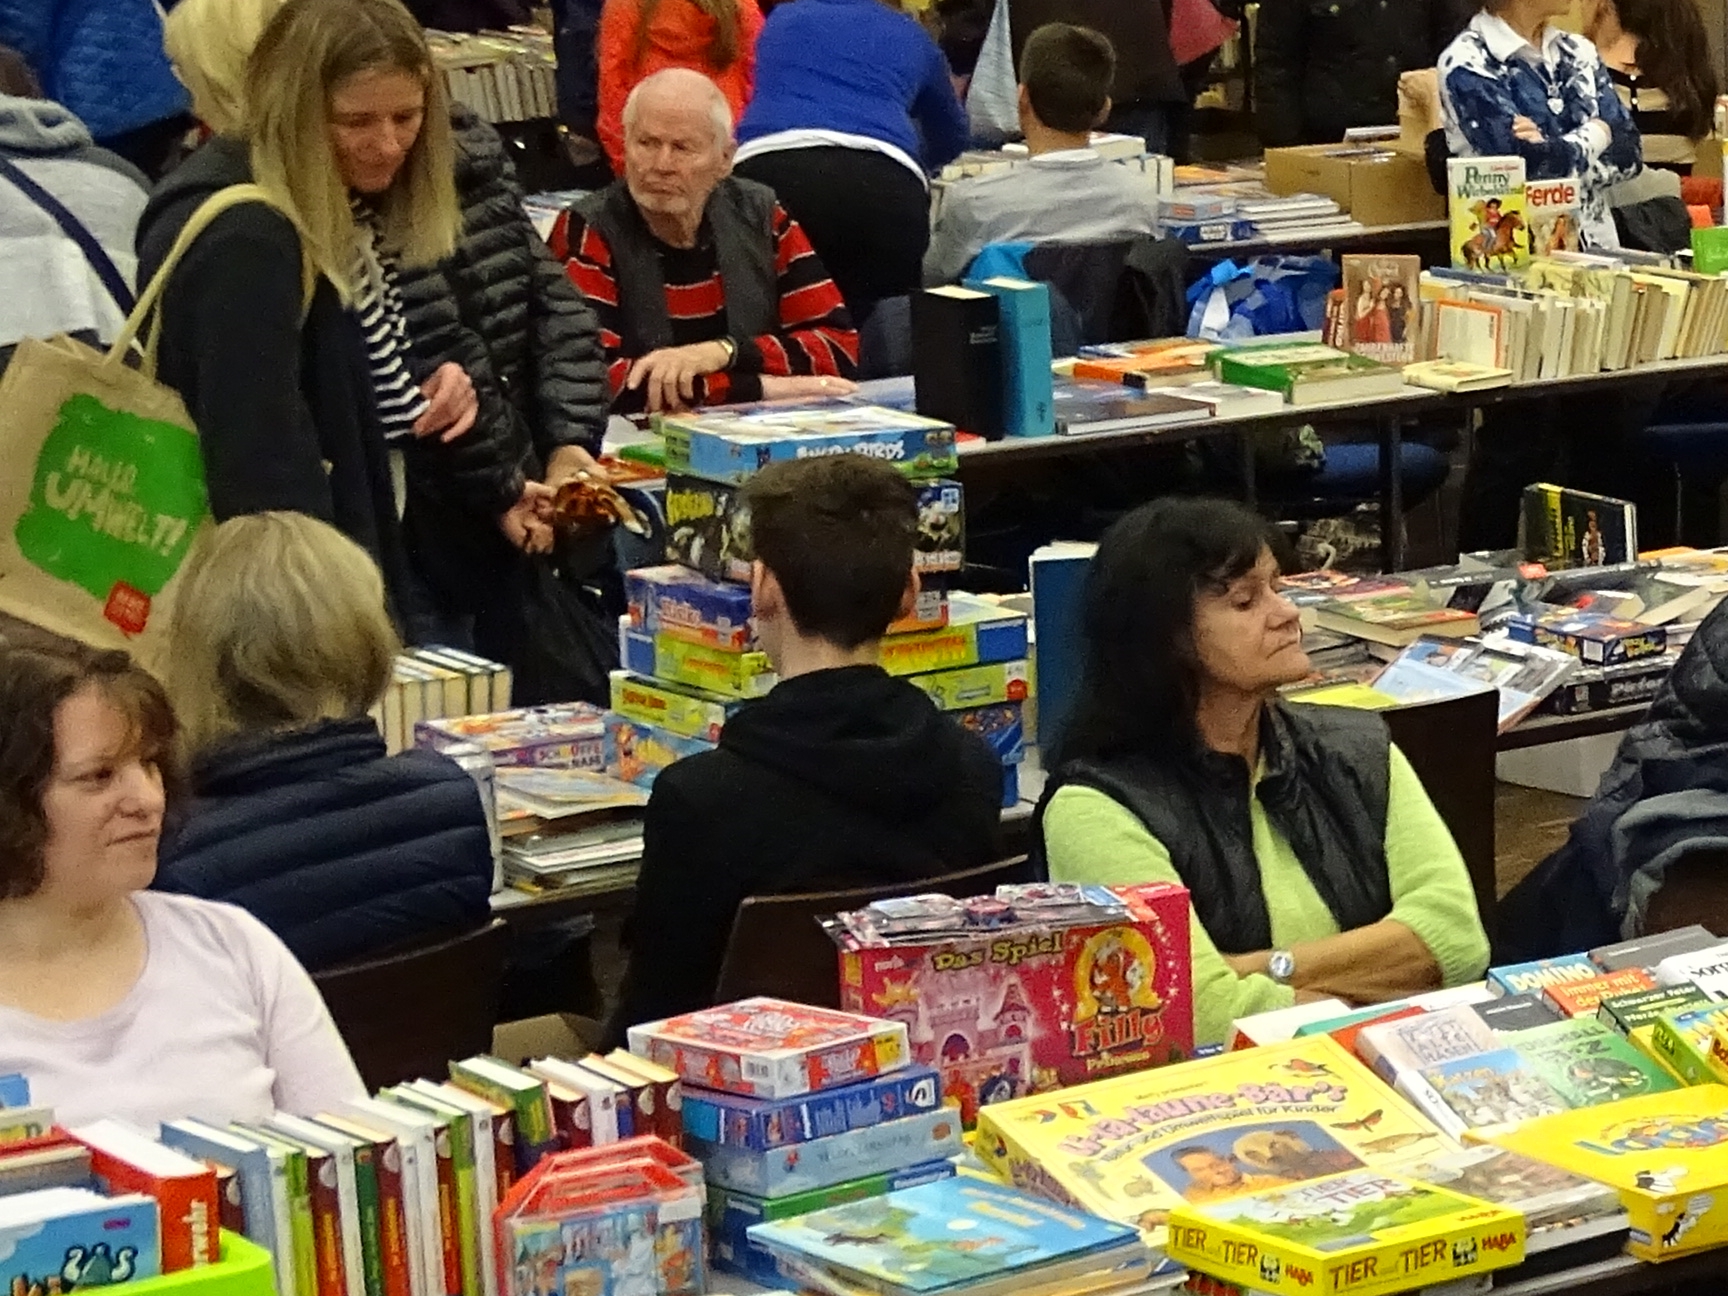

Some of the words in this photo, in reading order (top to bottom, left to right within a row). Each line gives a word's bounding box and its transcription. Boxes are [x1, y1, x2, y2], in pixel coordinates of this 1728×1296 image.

[1465, 166, 1510, 185] Penny
[931, 950, 986, 972] Das
[990, 932, 1064, 966] Spiel
[1506, 962, 1597, 992] DOMINO
[1615, 972, 1642, 990] mit
[1074, 1005, 1166, 1057] Filly
[1281, 1102, 1338, 1116] Kinder
[1172, 1222, 1208, 1254] TIER
[1222, 1238, 1259, 1269] TIER
[1284, 1262, 1315, 1287] HABA
[1328, 1255, 1379, 1291] TIER
[1400, 1238, 1449, 1282] TIER
[1481, 1228, 1518, 1254] HABA
